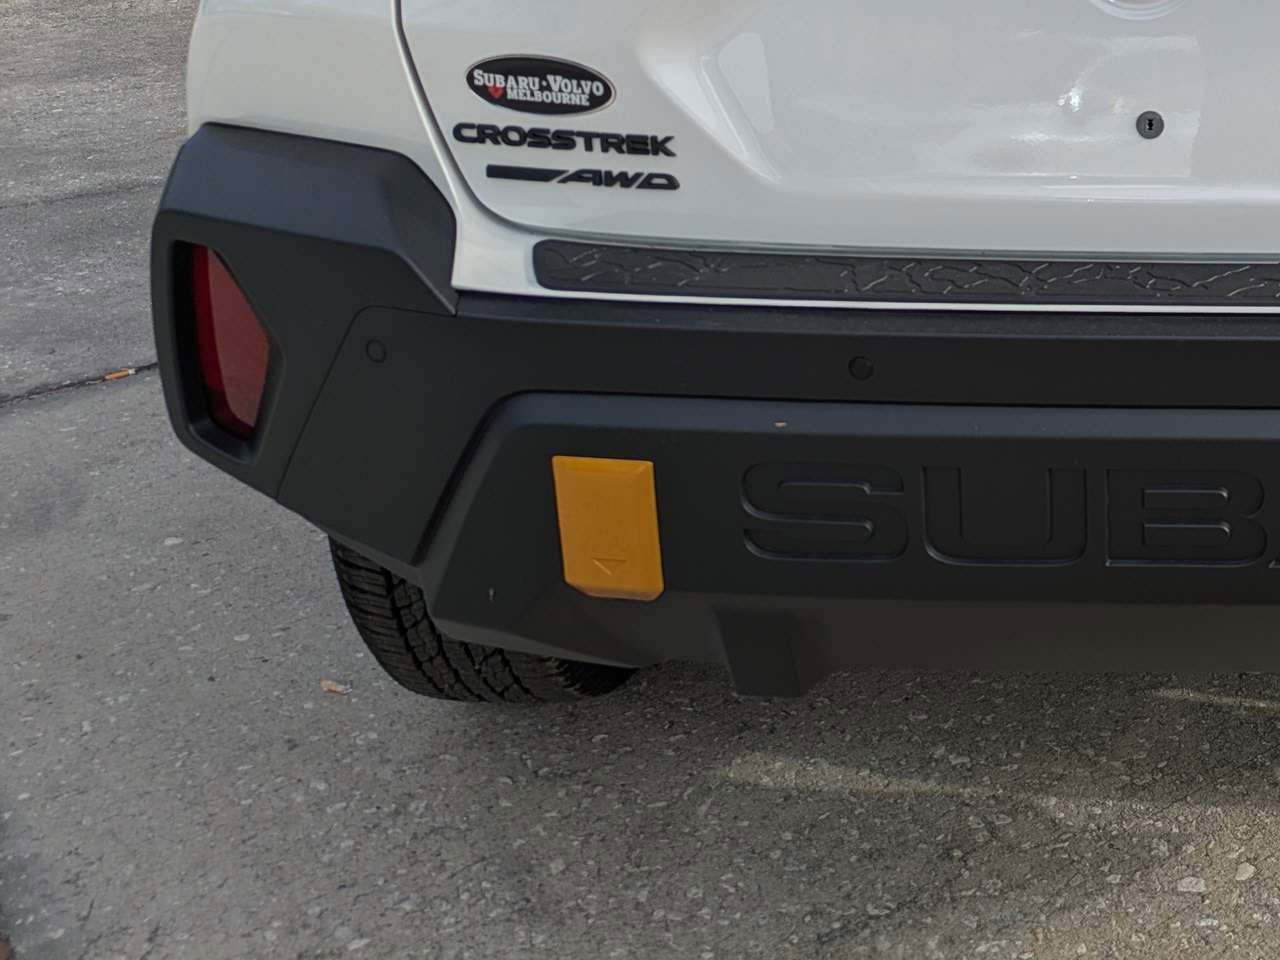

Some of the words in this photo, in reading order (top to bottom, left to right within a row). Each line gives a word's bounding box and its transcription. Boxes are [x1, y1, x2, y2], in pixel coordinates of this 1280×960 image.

[506, 87, 590, 106] MELBOURNE
[452, 122, 677, 157] CROSSTREK
[557, 168, 681, 191] AWD
